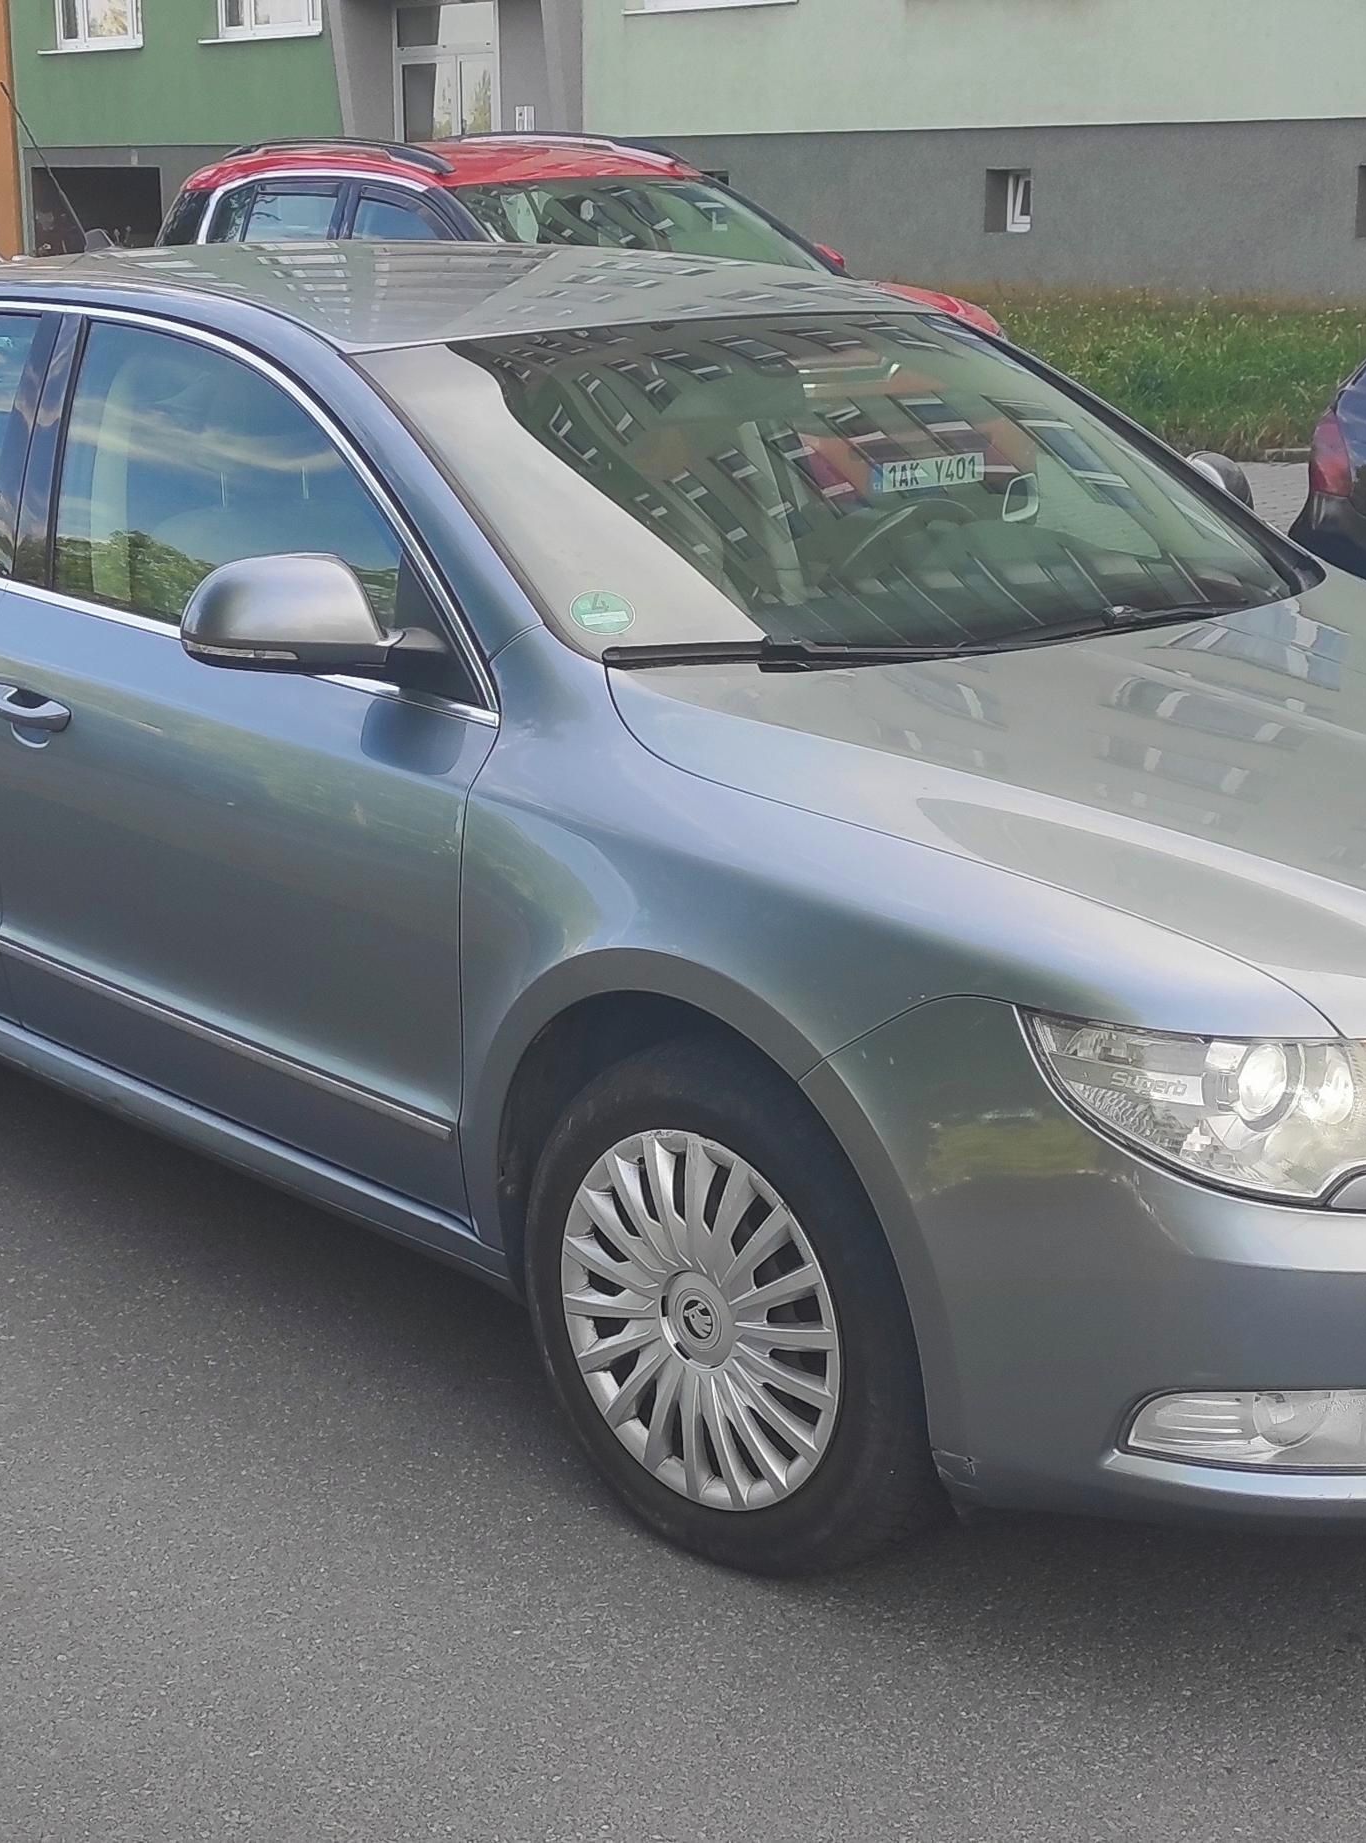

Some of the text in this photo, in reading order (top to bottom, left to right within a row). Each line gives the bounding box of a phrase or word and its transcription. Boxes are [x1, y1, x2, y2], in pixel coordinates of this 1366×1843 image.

[888, 456, 976, 488] 1AK Y401
[1110, 1071, 1188, 1097] Superb
